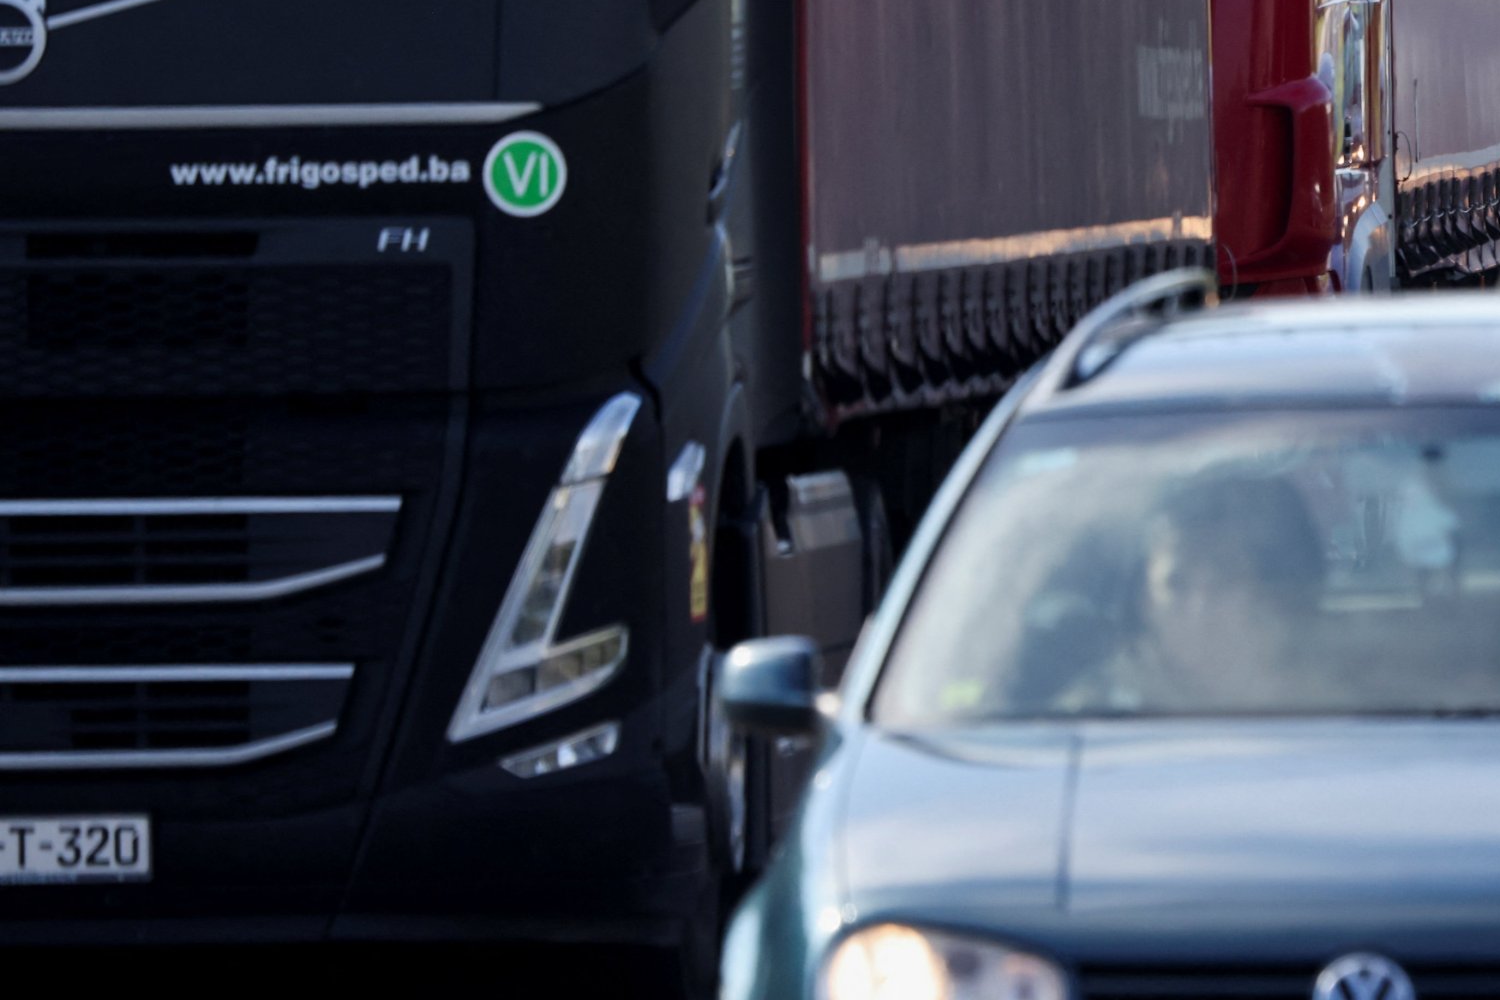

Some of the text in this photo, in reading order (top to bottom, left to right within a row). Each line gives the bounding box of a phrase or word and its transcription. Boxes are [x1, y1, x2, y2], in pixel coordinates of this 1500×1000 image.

[170, 151, 550, 197] www.frigosped.ba VI
[377, 228, 430, 252] FH
